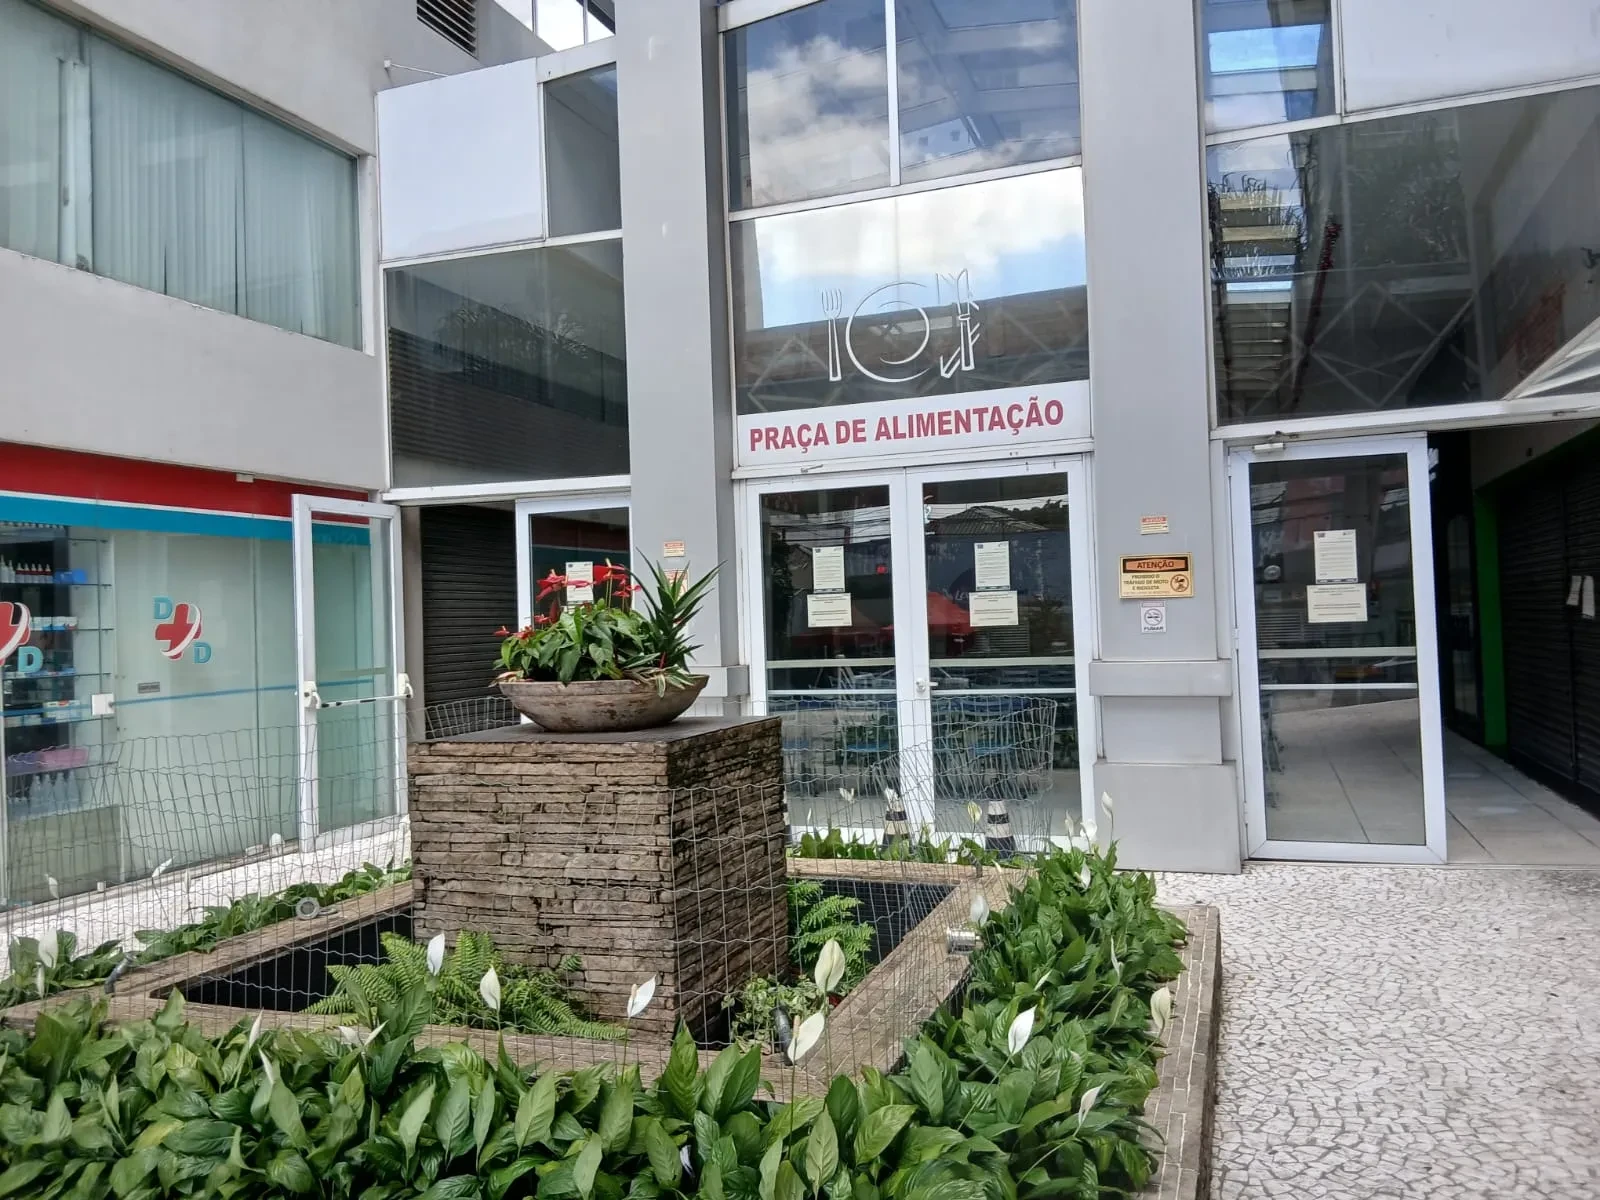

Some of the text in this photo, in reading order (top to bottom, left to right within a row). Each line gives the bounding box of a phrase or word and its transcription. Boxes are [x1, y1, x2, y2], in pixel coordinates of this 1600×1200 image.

[750, 396, 1064, 453] PRAÇA DE ALIMENTAÇÃO
[1137, 560, 1174, 569] ATENÇÃO
[153, 597, 173, 620] D
[18, 646, 43, 673] D
[193, 642, 212, 664] D
